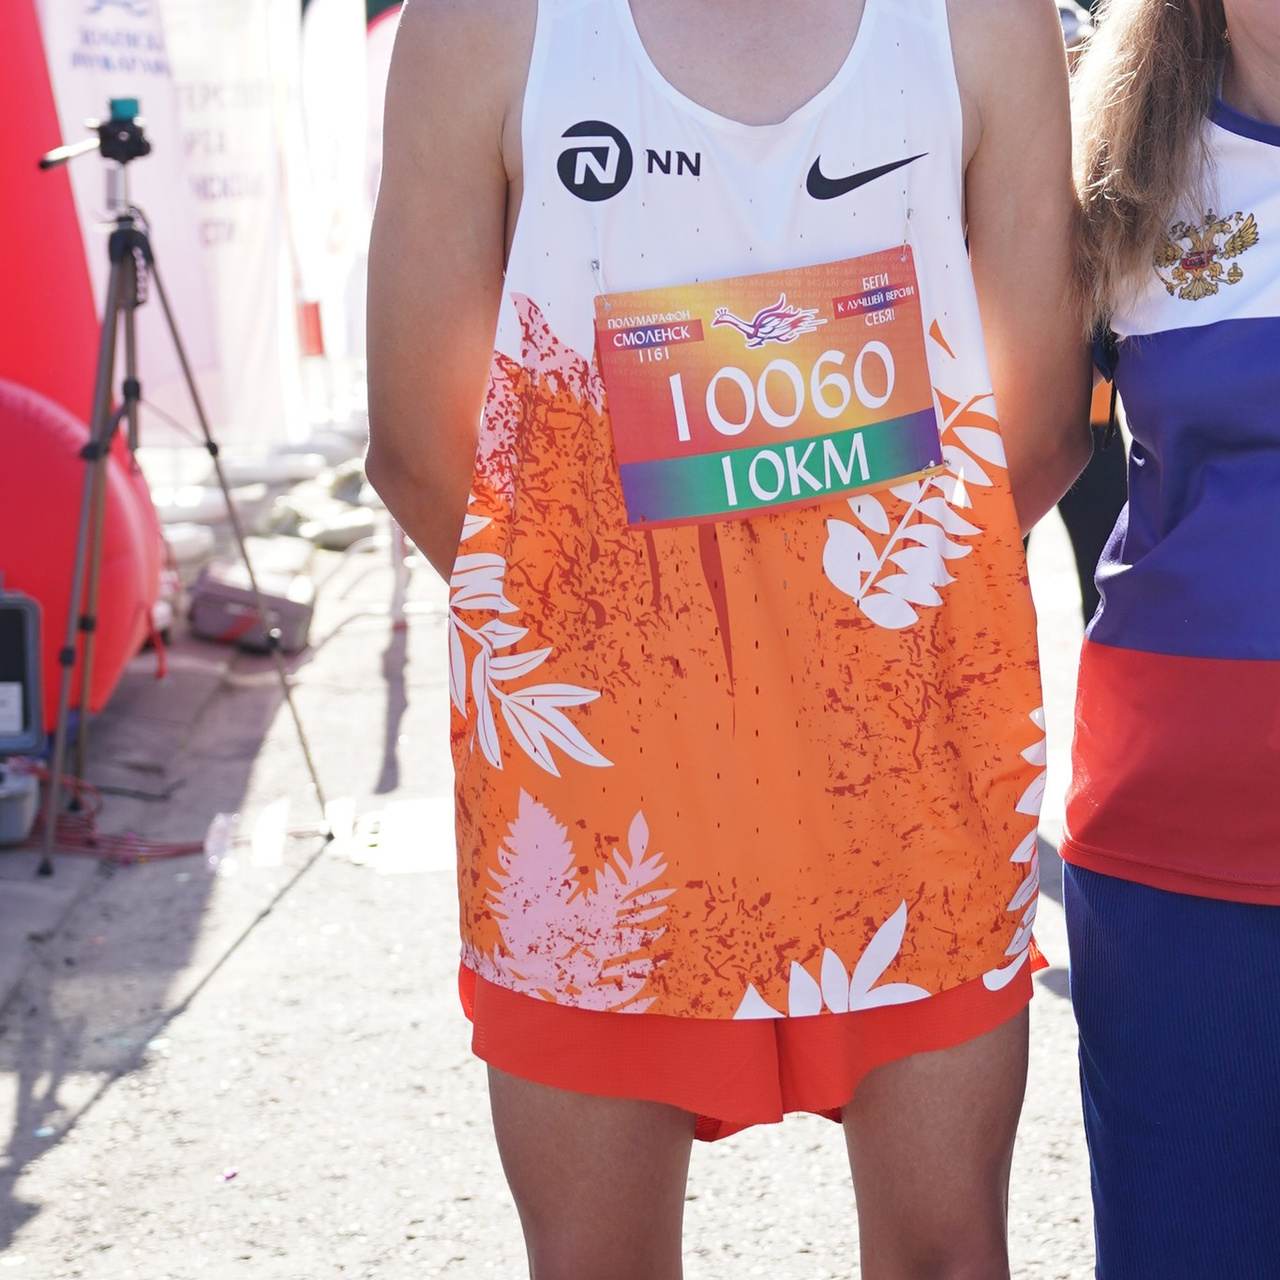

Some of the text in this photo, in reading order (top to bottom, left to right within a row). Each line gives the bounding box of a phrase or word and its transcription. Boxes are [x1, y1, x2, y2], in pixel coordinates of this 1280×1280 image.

[645, 149, 701, 176] NN
[862, 272, 889, 291] БЕГИ
[837, 286, 915, 313] К ЛУЧШЕЙ ВЕРСИИ
[607, 310, 690, 329] ПОЛУМАРАФОН
[865, 308, 896, 327] СЕБЯ!
[613, 325, 690, 347] СМОЛЕНСК
[639, 346, 670, 363] 1161
[668, 340, 896, 443] 10060
